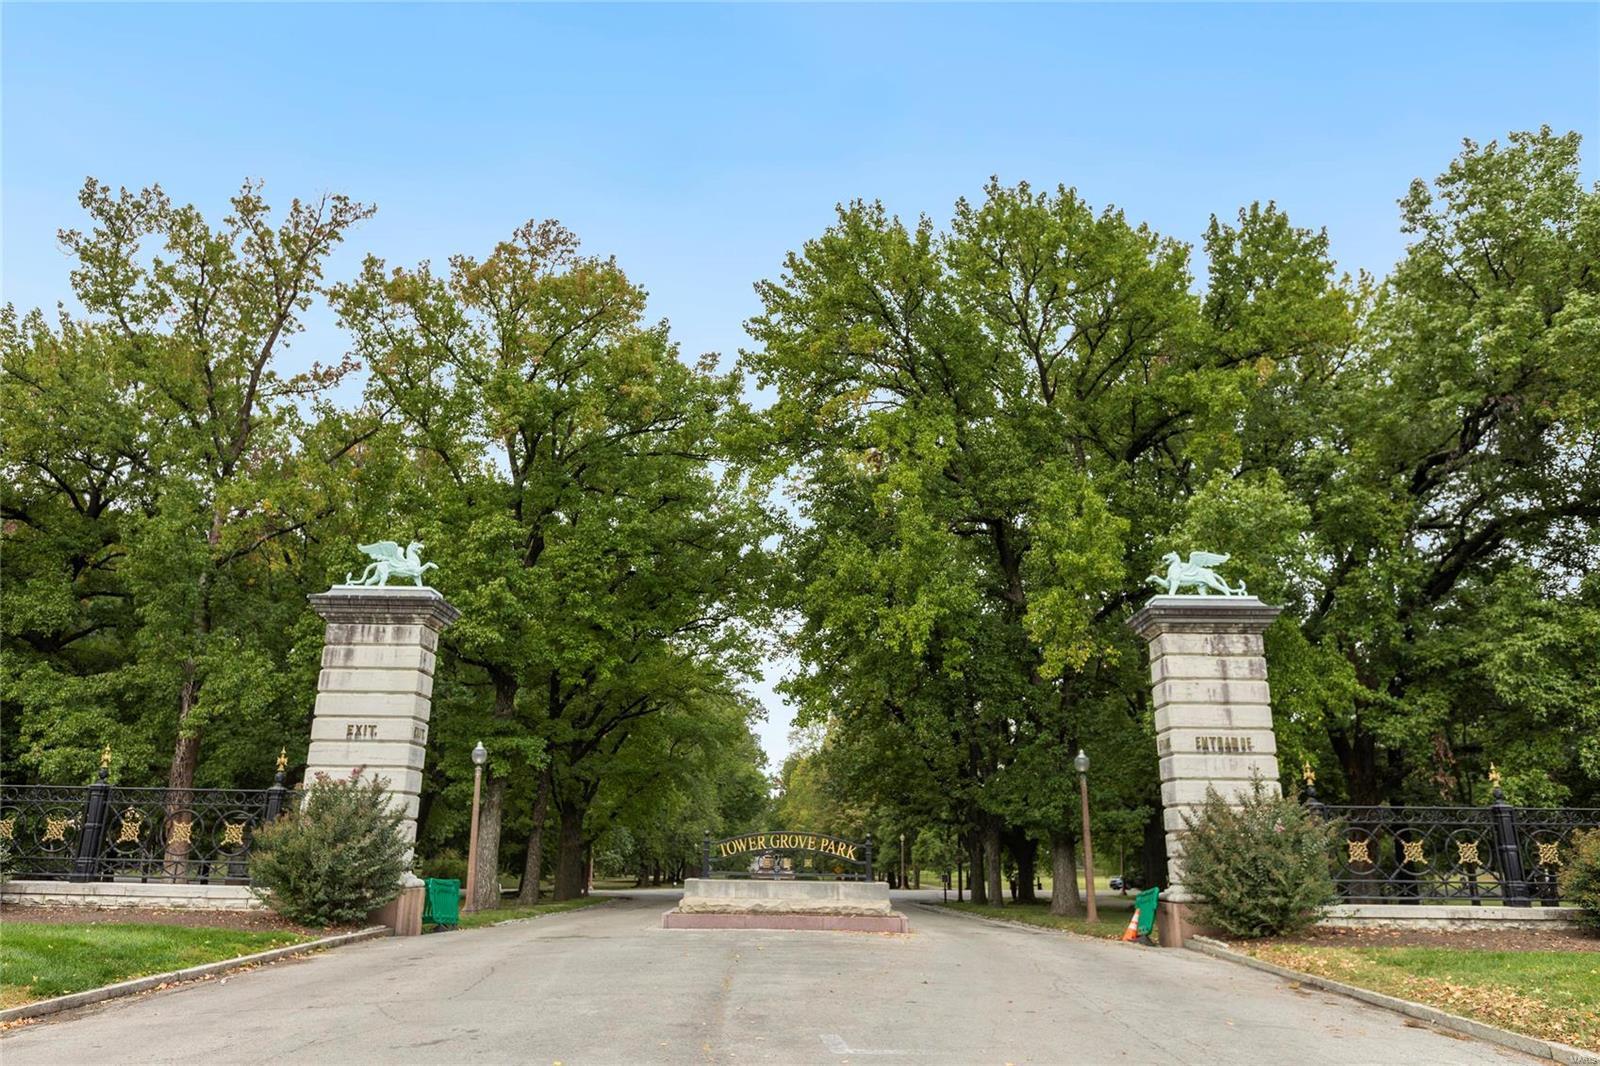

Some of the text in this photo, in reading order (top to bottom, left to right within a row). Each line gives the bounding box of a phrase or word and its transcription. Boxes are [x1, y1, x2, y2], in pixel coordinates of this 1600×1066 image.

[719, 834, 857, 861] TOWER GROVE PARK
